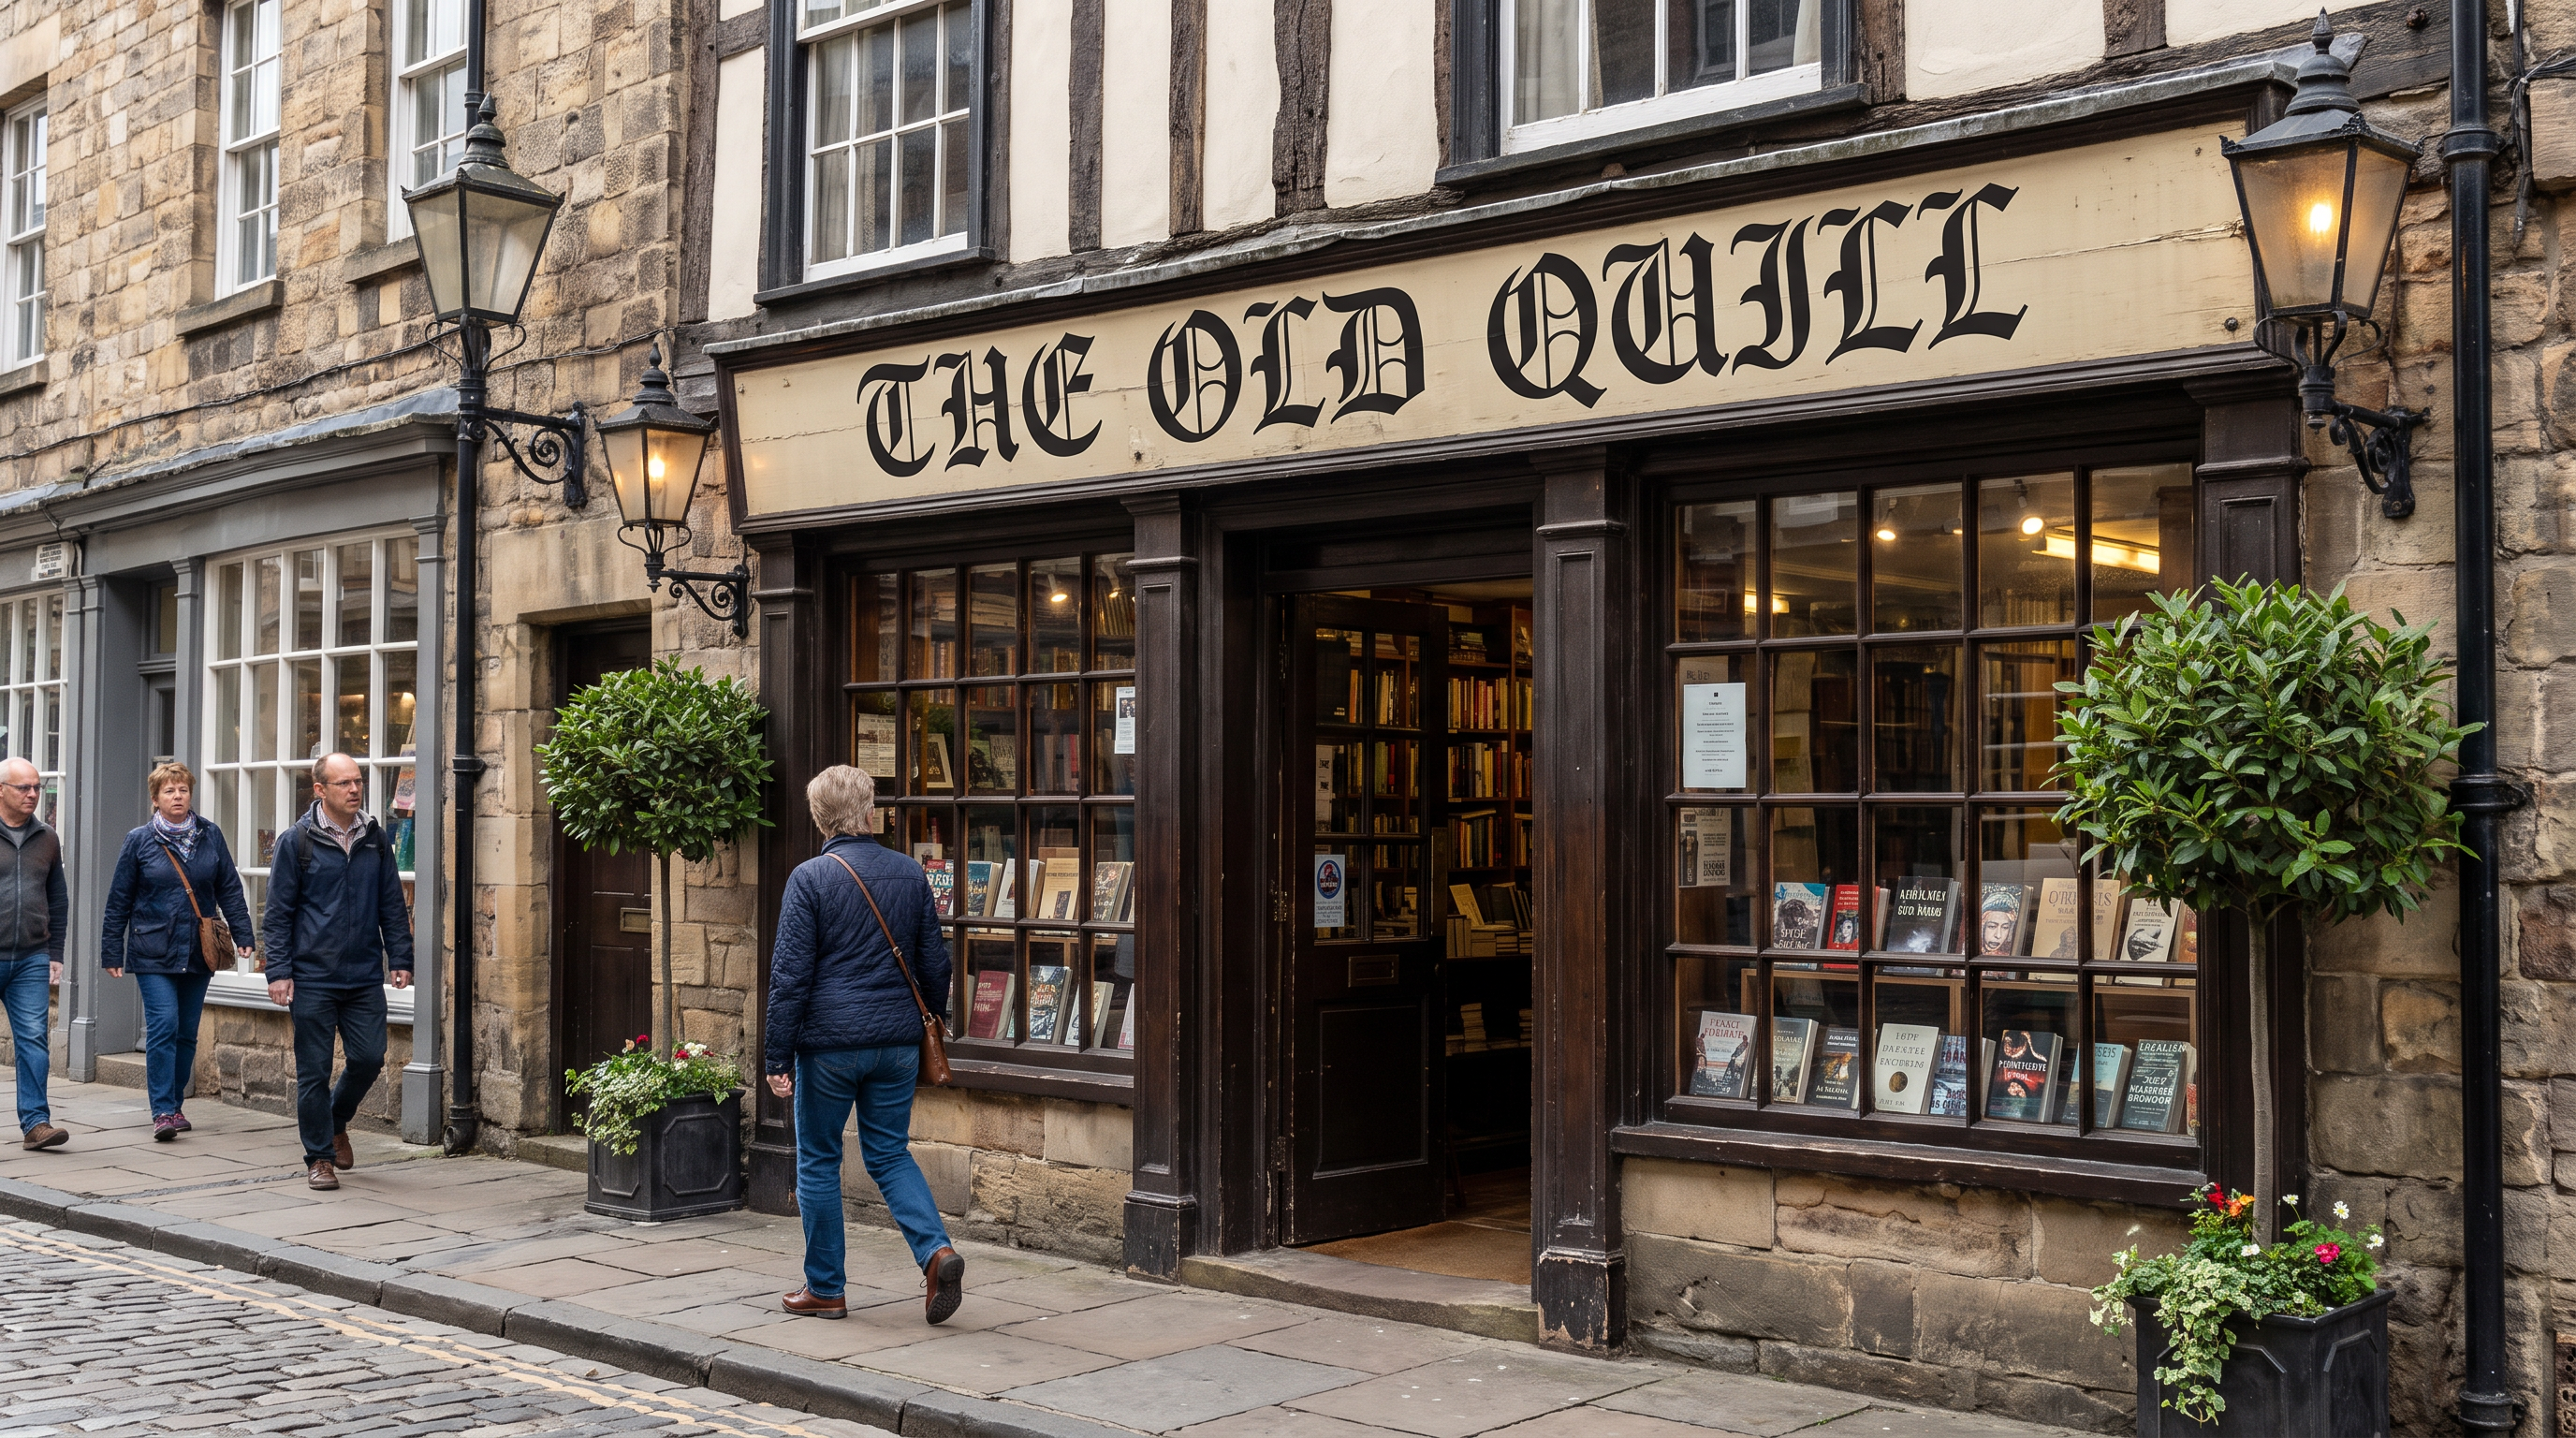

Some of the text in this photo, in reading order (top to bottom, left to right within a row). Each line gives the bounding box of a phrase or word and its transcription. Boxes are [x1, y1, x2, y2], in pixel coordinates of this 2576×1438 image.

[857, 183, 2029, 477] THE OLD QUILL
